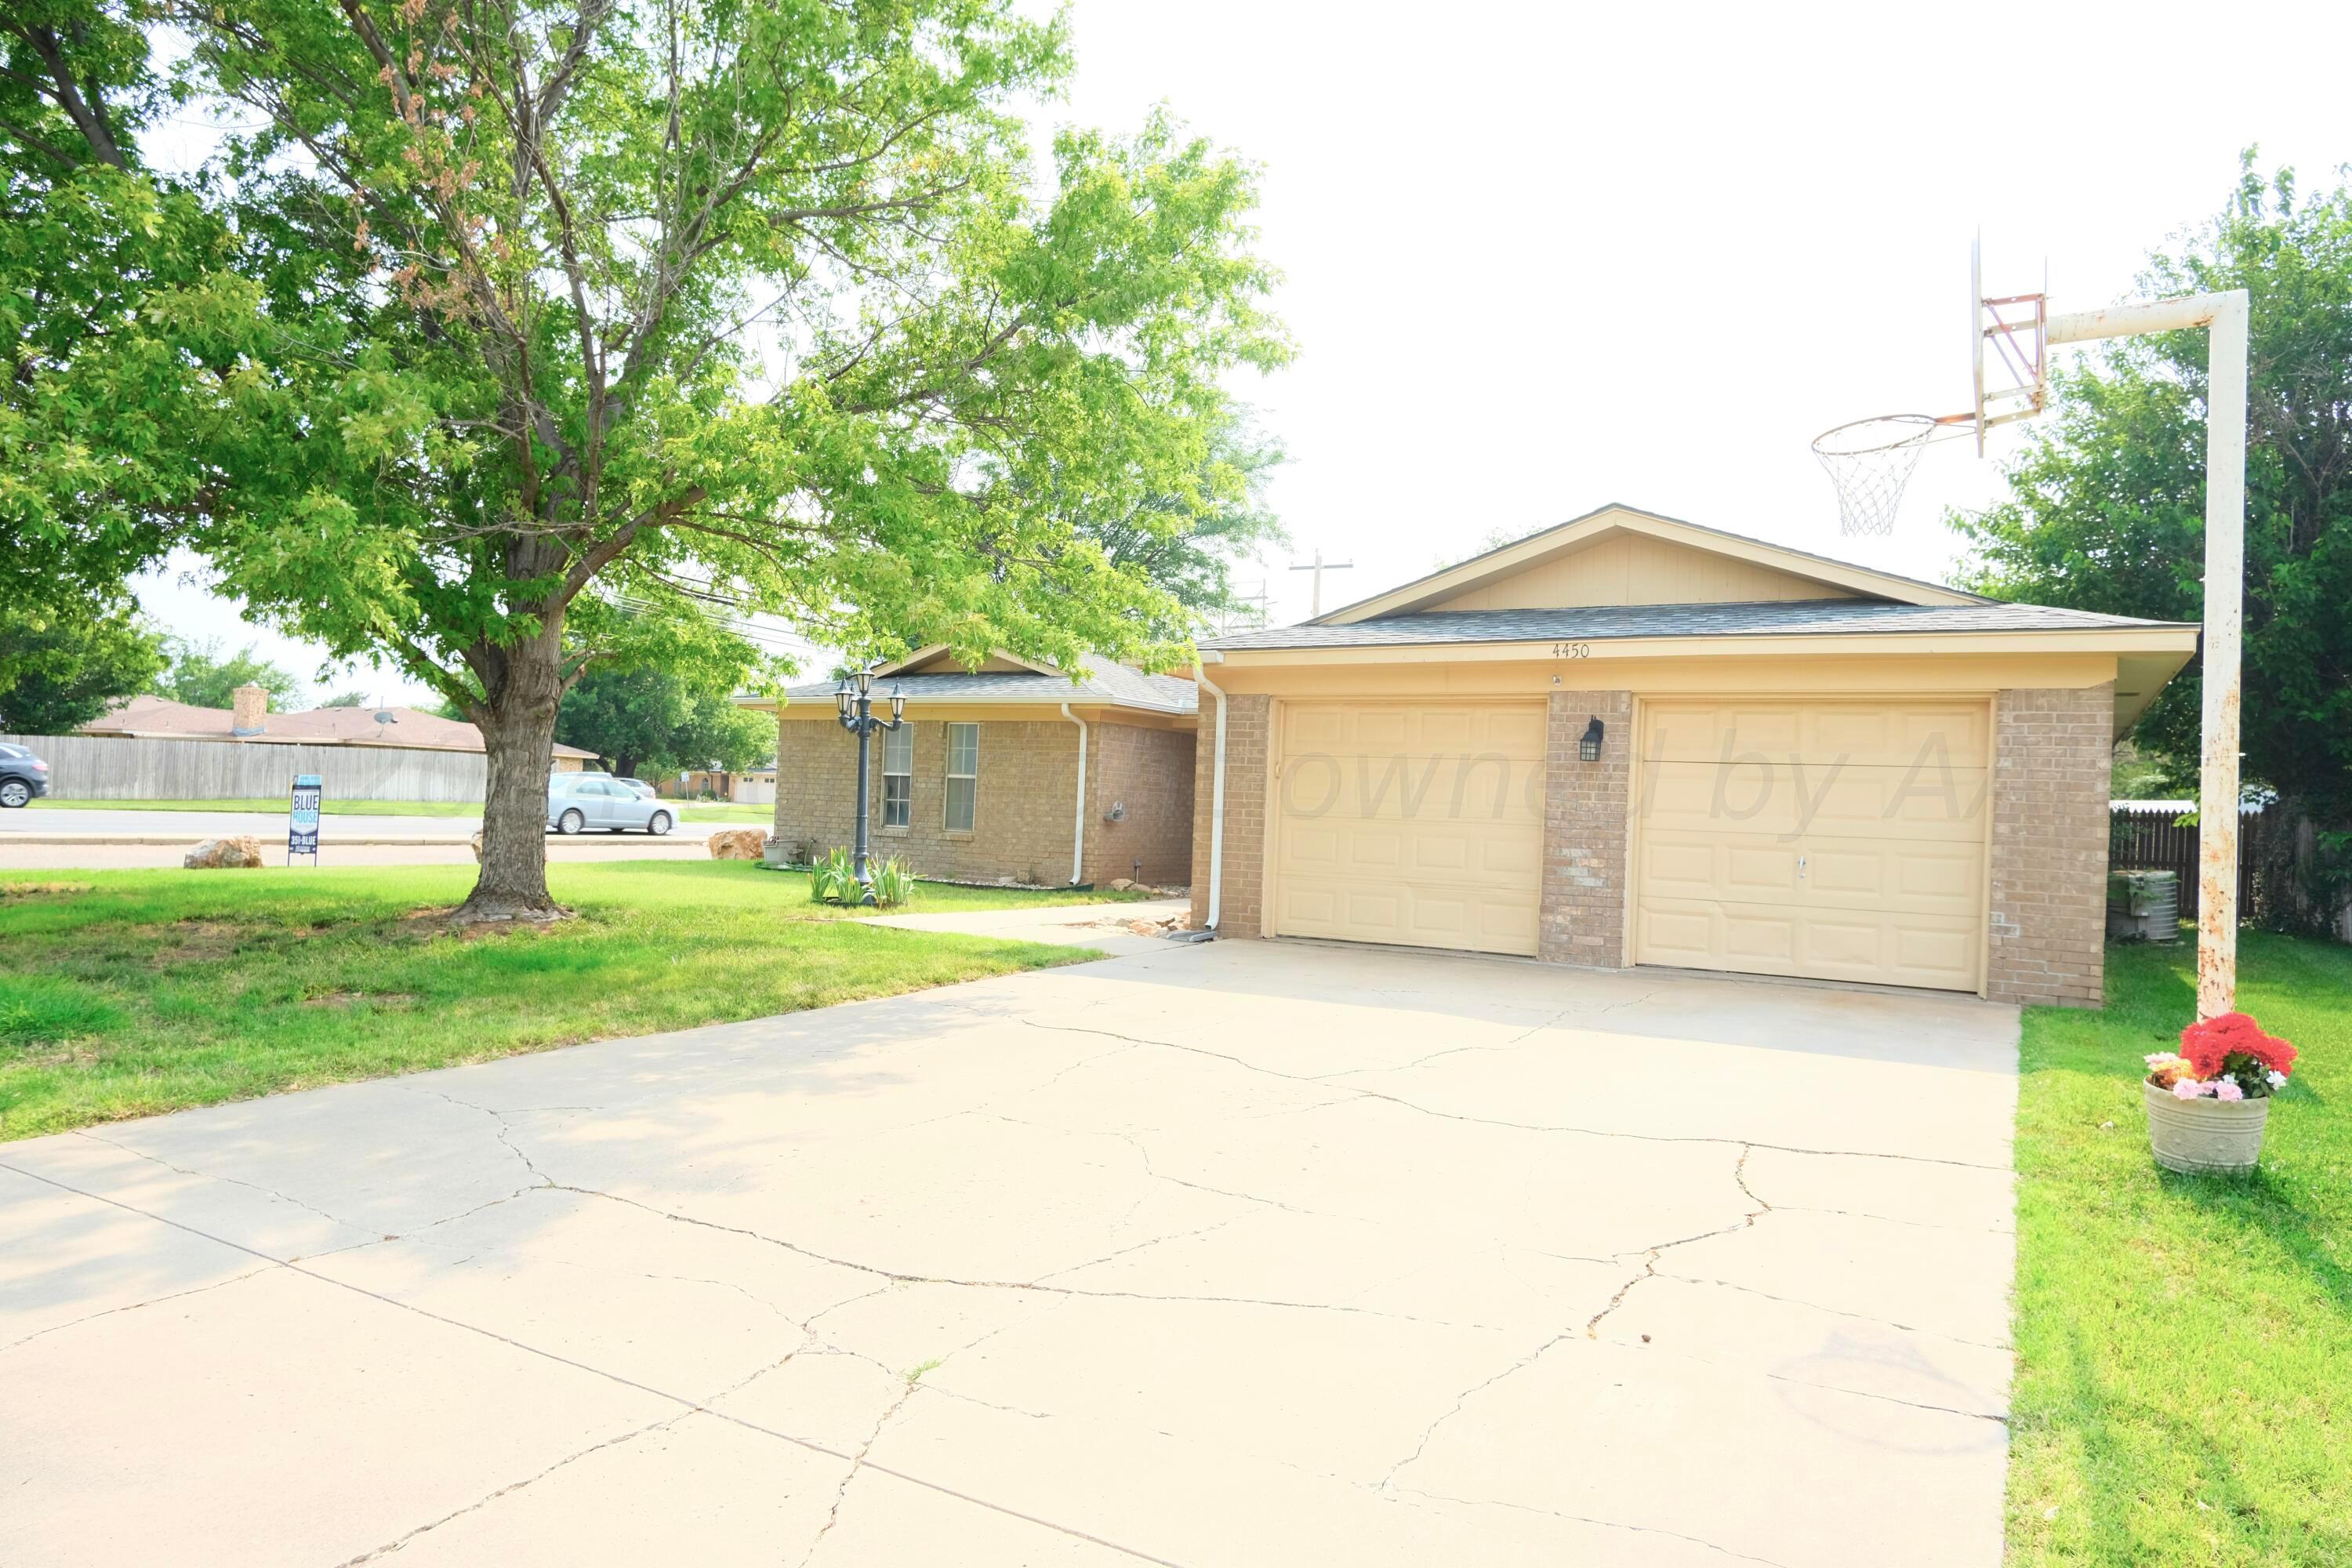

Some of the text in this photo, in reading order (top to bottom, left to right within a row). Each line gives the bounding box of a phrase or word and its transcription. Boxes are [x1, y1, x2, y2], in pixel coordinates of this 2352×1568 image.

[1552, 643, 1589, 659] 4450
[293, 795, 319, 811] BLUE
[292, 811, 318, 823] HOUSE
[290, 835, 317, 846] 351-BLUE
